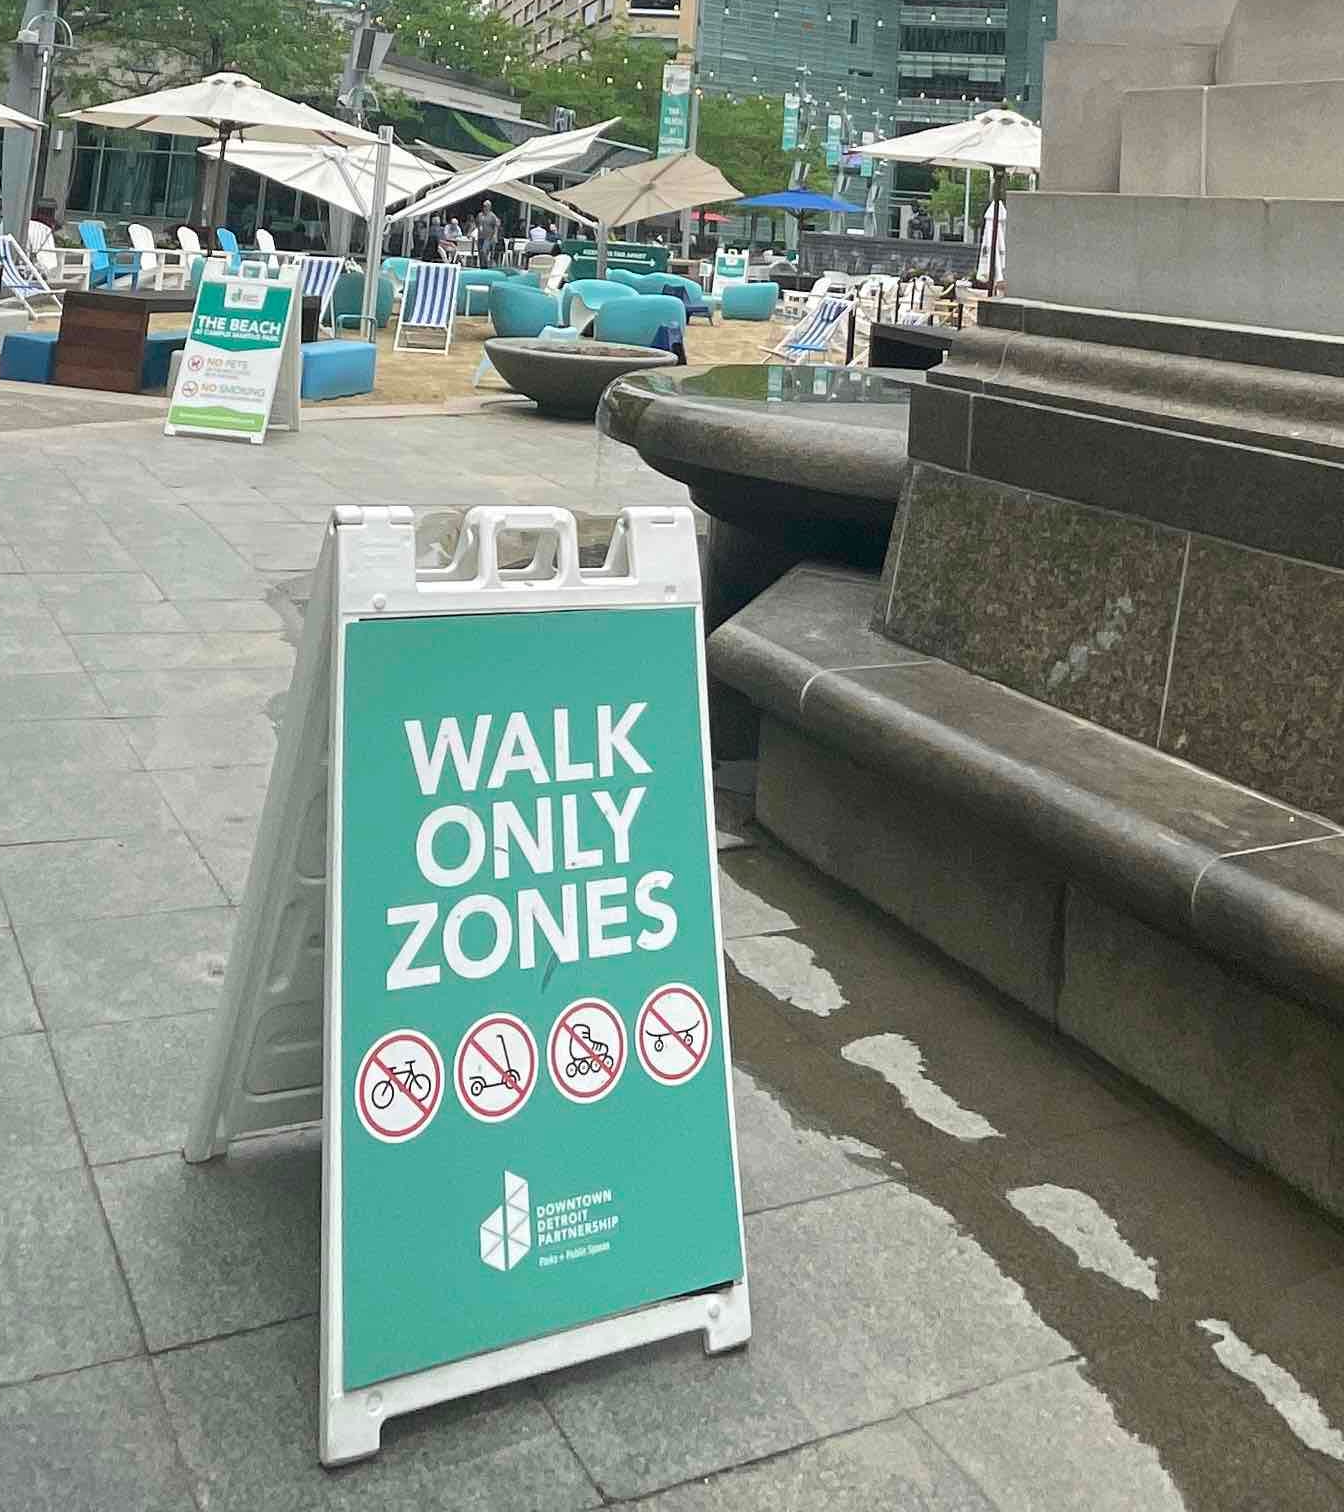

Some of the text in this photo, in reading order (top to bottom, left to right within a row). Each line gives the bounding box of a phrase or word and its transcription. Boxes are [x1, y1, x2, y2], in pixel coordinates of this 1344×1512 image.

[198, 315, 281, 335] THE BEACH
[207, 358, 223, 367] NO
[200, 384, 217, 392] NO
[404, 702, 654, 796] WALK
[416, 787, 647, 888] ONLY
[386, 870, 678, 991] ZONES
[536, 1189, 612, 1218] DOWNTOWN
[537, 1209, 588, 1232] DETROIT
[538, 1215, 619, 1247] PARTNERSHIP
